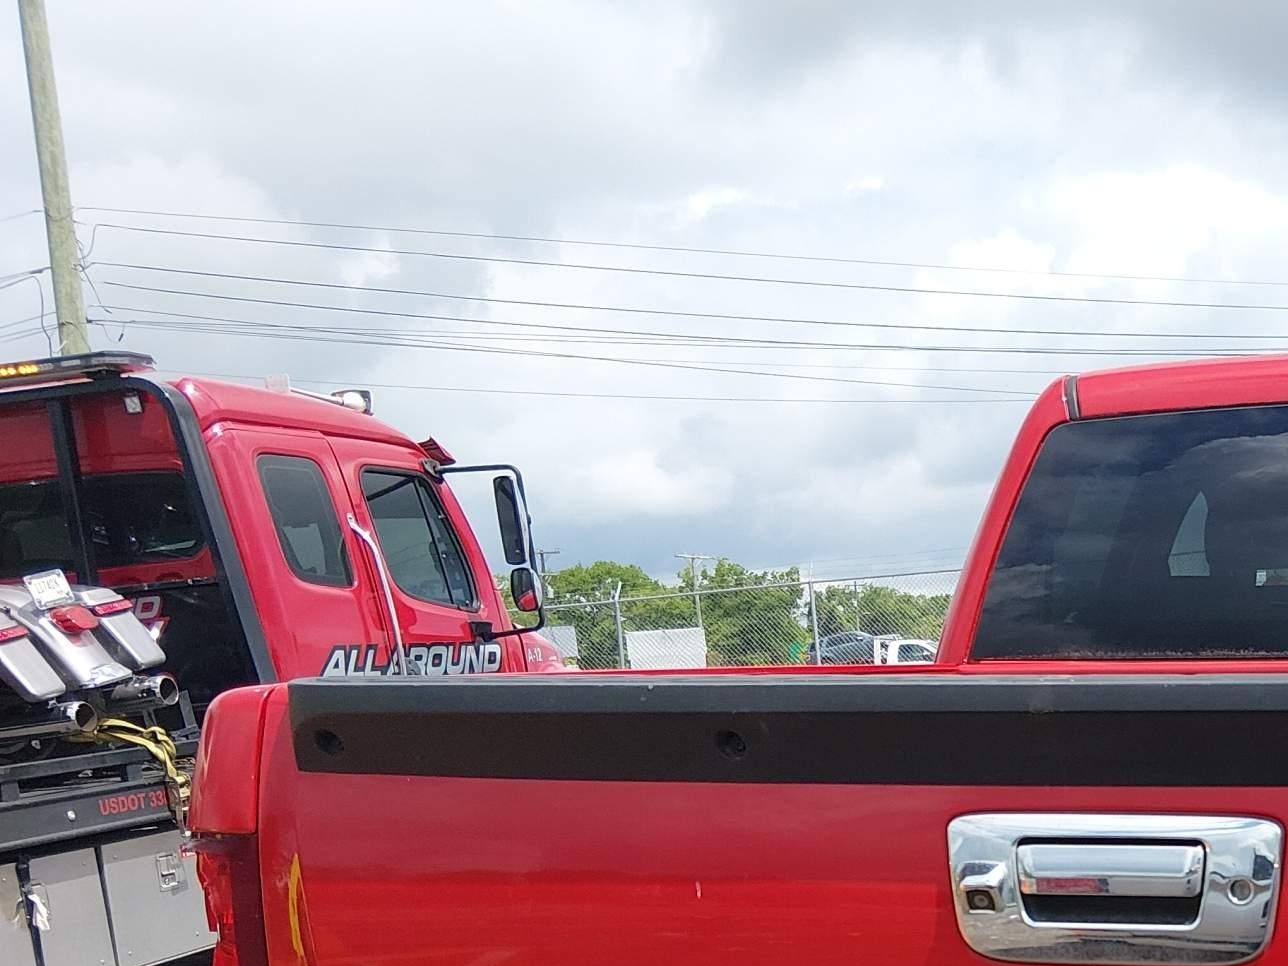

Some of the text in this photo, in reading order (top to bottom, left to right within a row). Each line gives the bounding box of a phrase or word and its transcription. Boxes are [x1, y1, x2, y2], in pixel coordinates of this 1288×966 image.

[322, 646, 384, 677] ALL
[528, 648, 543, 663] A-12
[98, 790, 147, 817] USDOT
